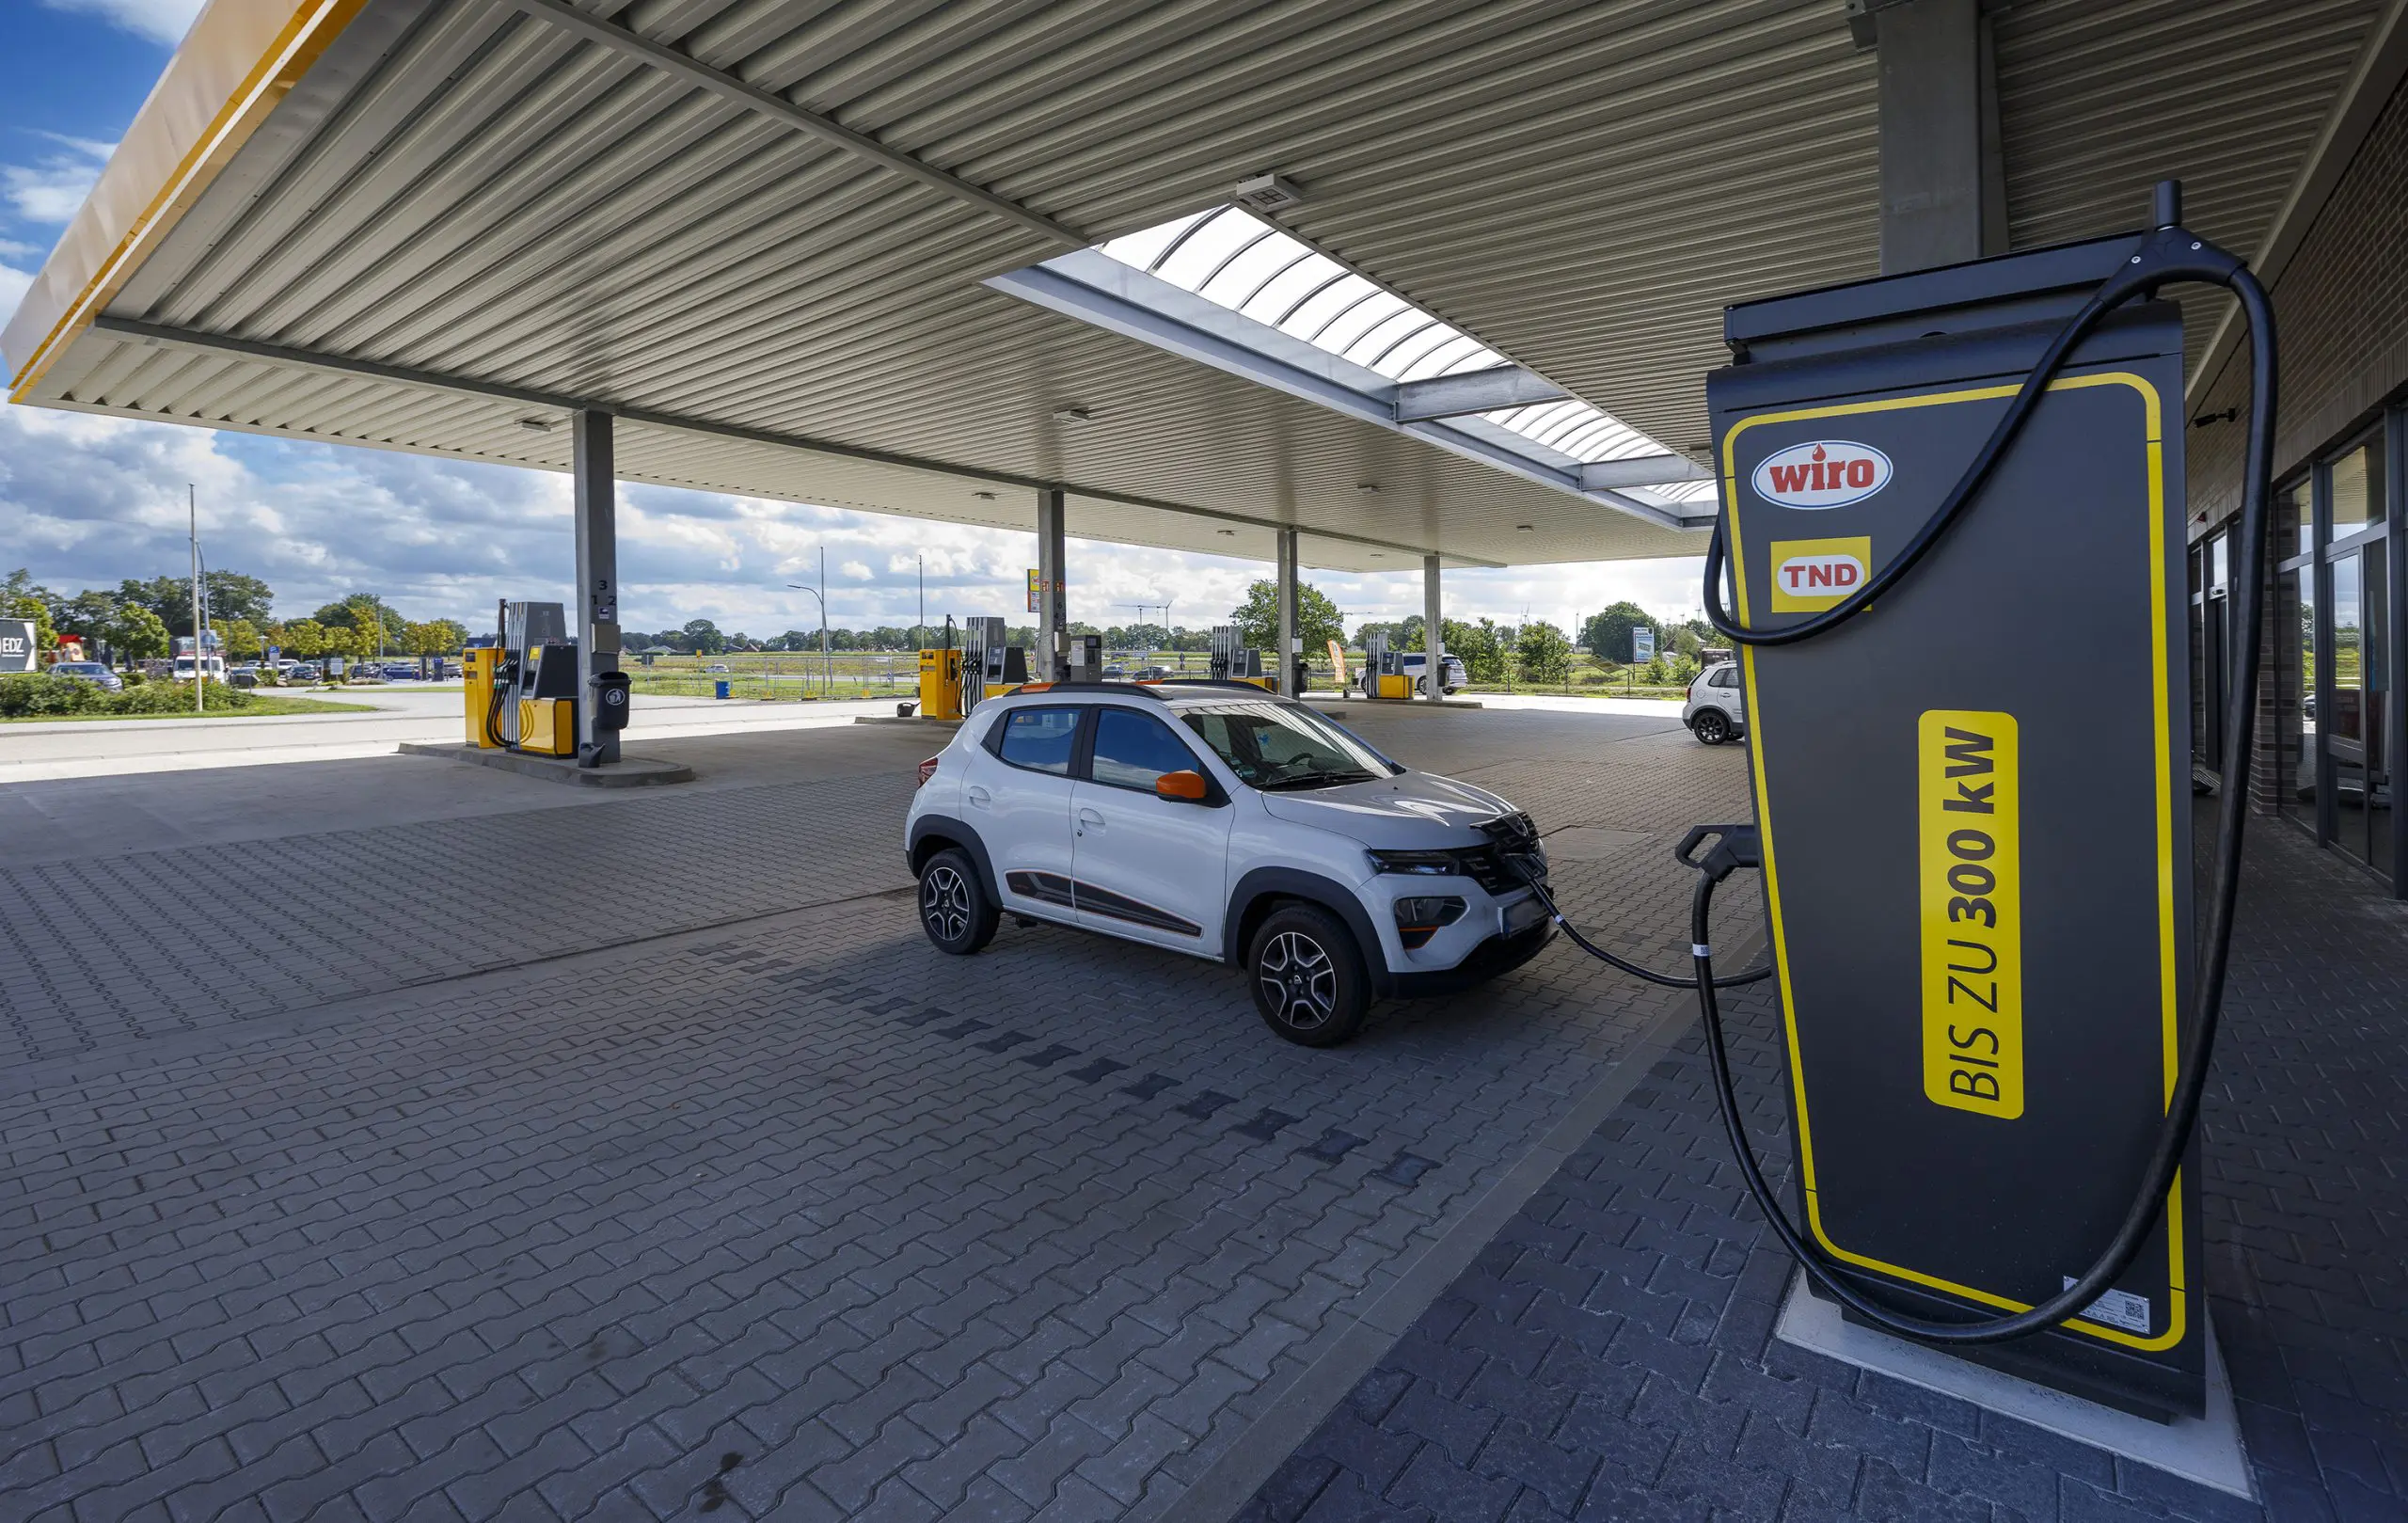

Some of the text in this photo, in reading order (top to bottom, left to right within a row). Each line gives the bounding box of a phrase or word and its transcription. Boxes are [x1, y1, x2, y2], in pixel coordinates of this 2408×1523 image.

[1769, 442, 1875, 493] wiro
[598, 579, 608, 591] 3
[1783, 563, 1858, 588] TND
[591, 595, 617, 606] 1 2
[1942, 725, 2001, 1102] BIS ZU 300 kW
